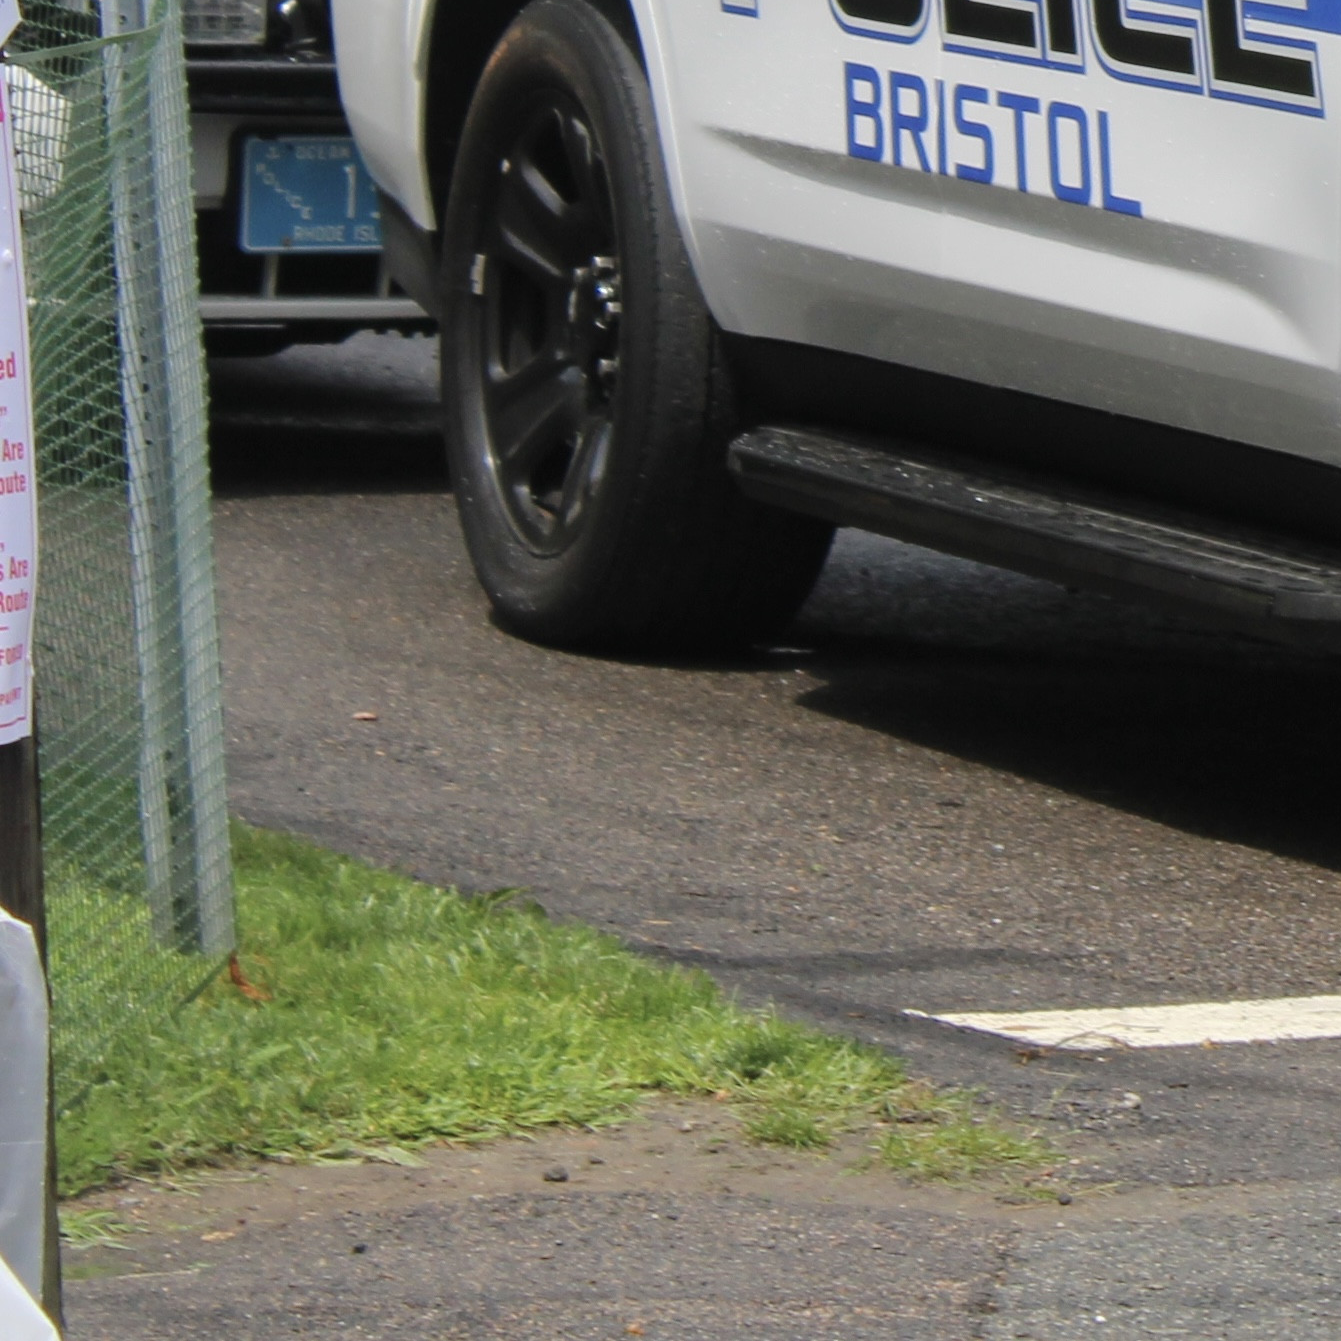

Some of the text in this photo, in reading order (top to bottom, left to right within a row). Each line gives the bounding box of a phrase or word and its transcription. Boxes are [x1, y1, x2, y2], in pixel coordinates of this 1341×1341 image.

[844, 61, 1143, 218] BRISTOL
[3, 439, 24, 462] Are
[9, 556, 28, 580] Are
